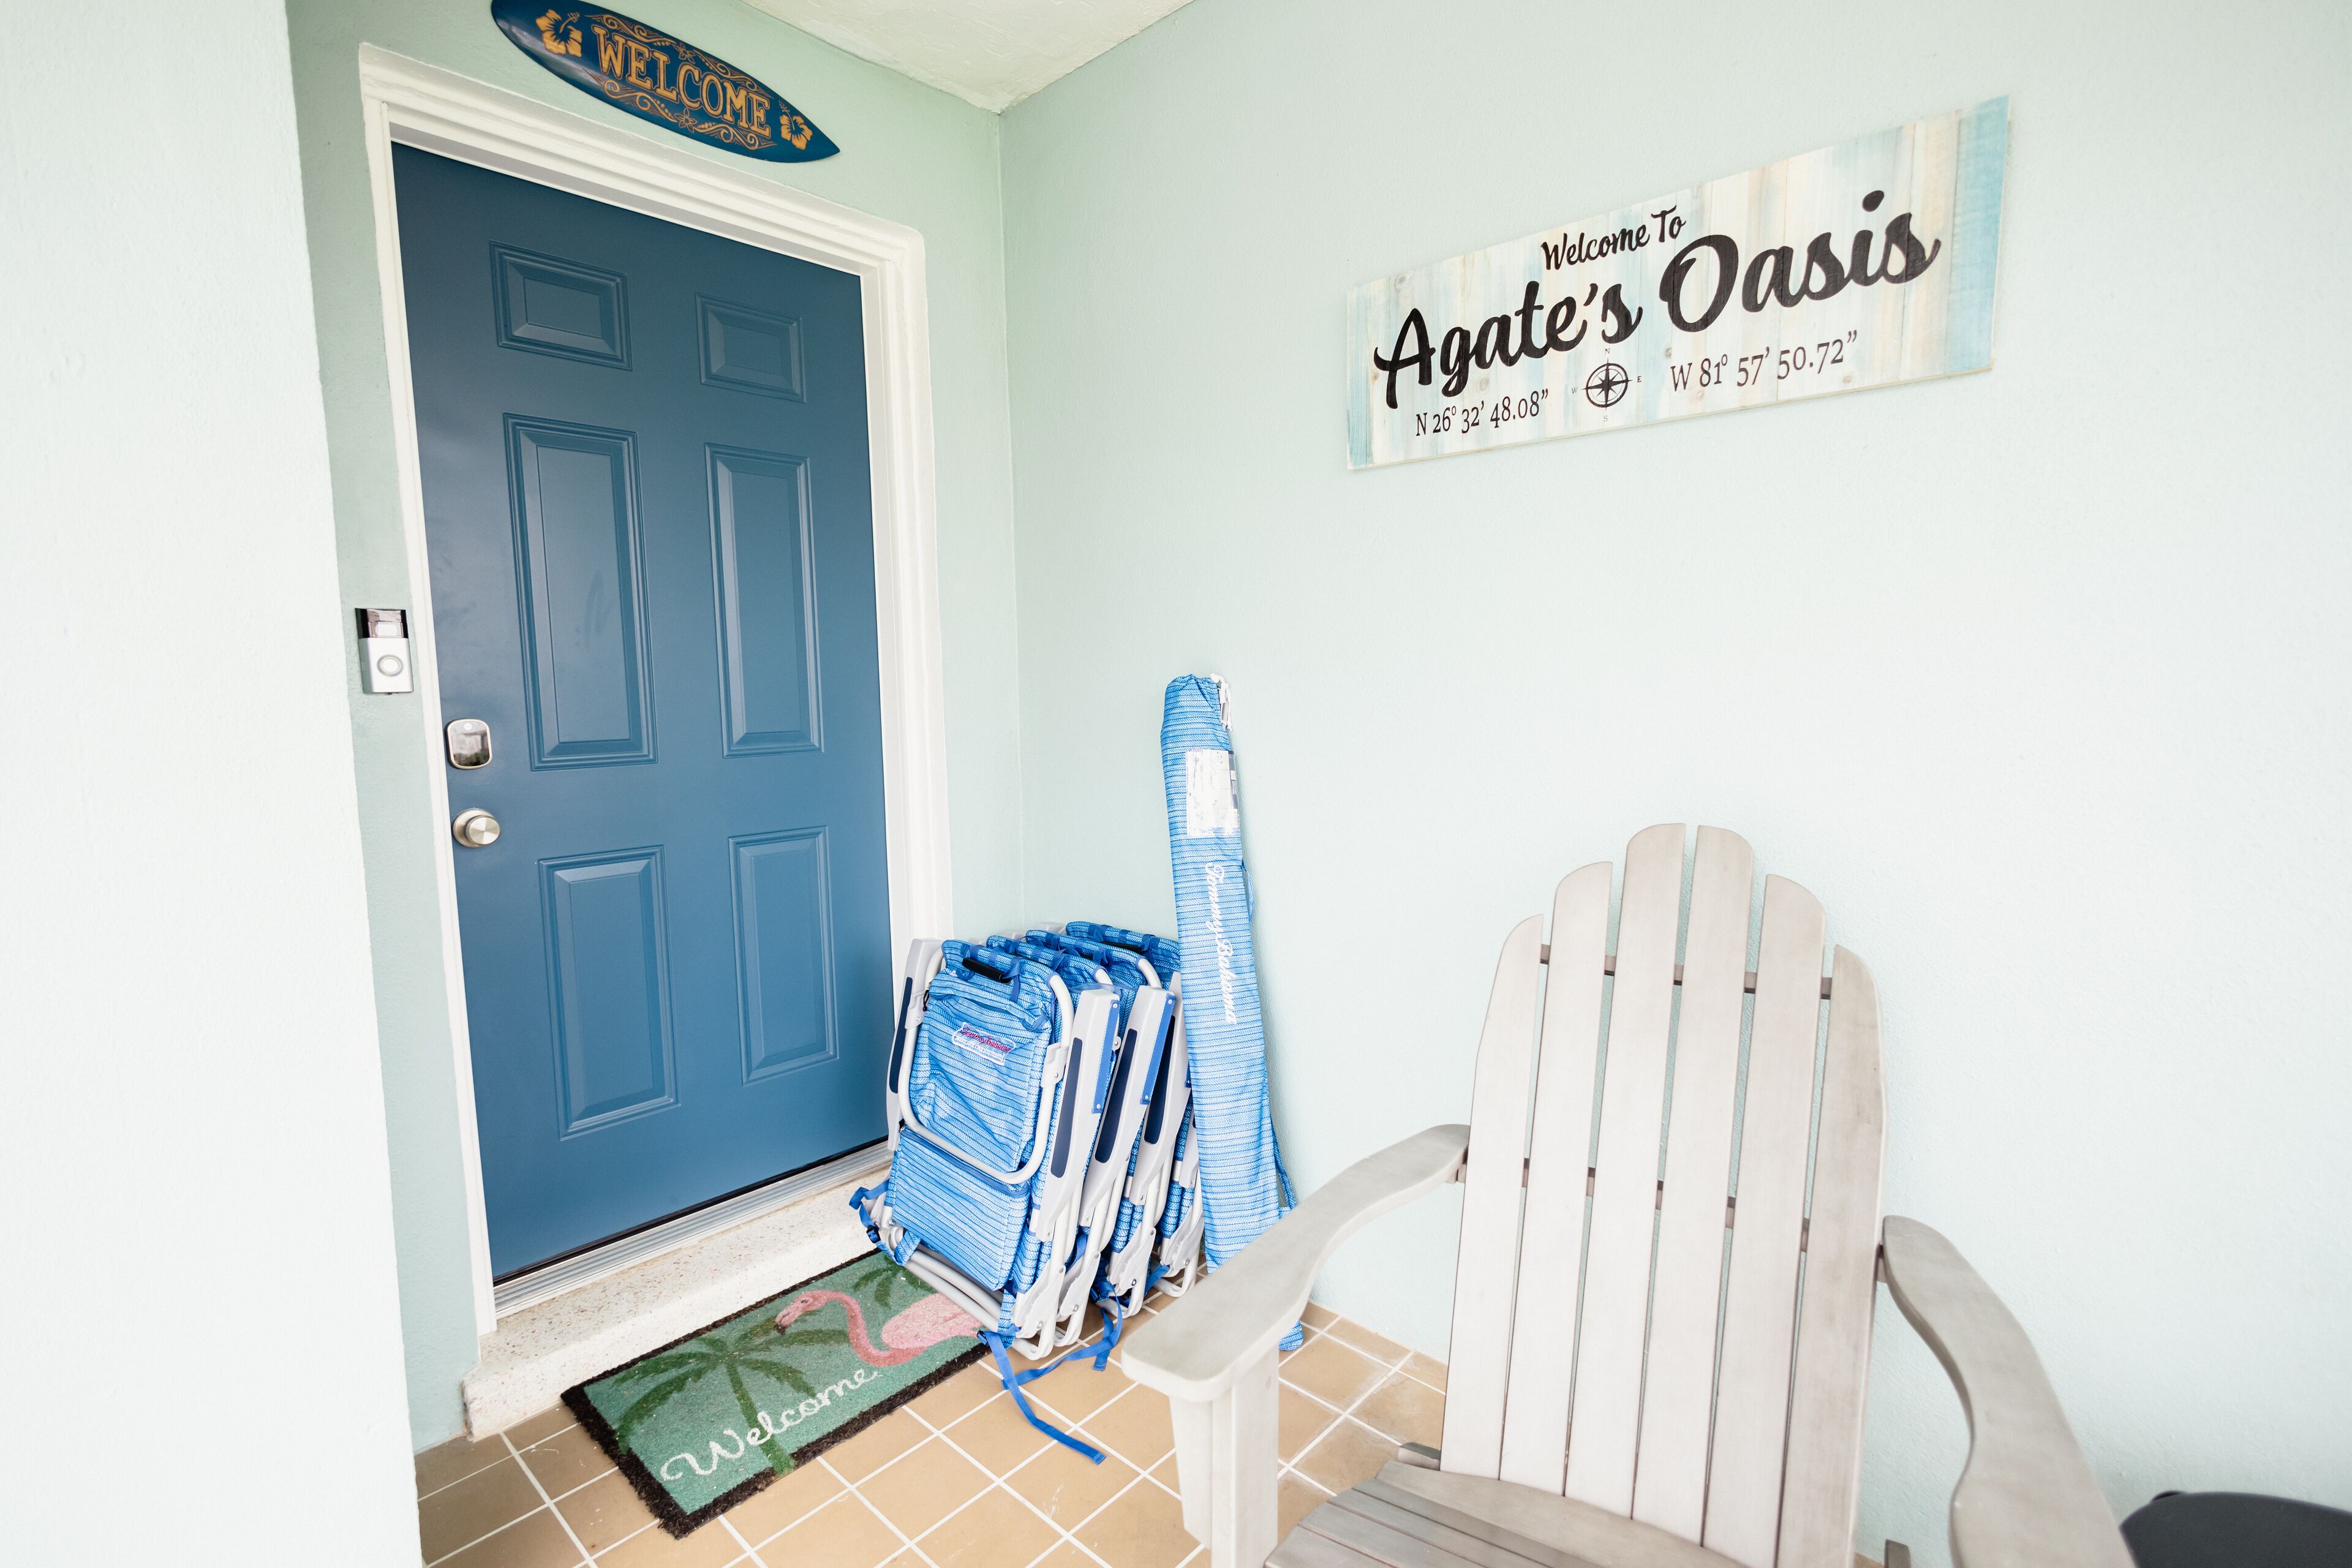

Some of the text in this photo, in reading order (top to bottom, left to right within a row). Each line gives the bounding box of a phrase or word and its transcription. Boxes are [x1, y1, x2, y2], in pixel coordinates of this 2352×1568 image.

[592, 24, 771, 137] WELCOME
[1540, 205, 1686, 270] Welcome To
[1374, 190, 1940, 409] Agate's Oasis
[1415, 412, 1428, 437] N
[1670, 362, 1692, 392] W
[1205, 862, 1237, 1025] Tommy Bahama
[660, 1368, 883, 1482] Welcome
